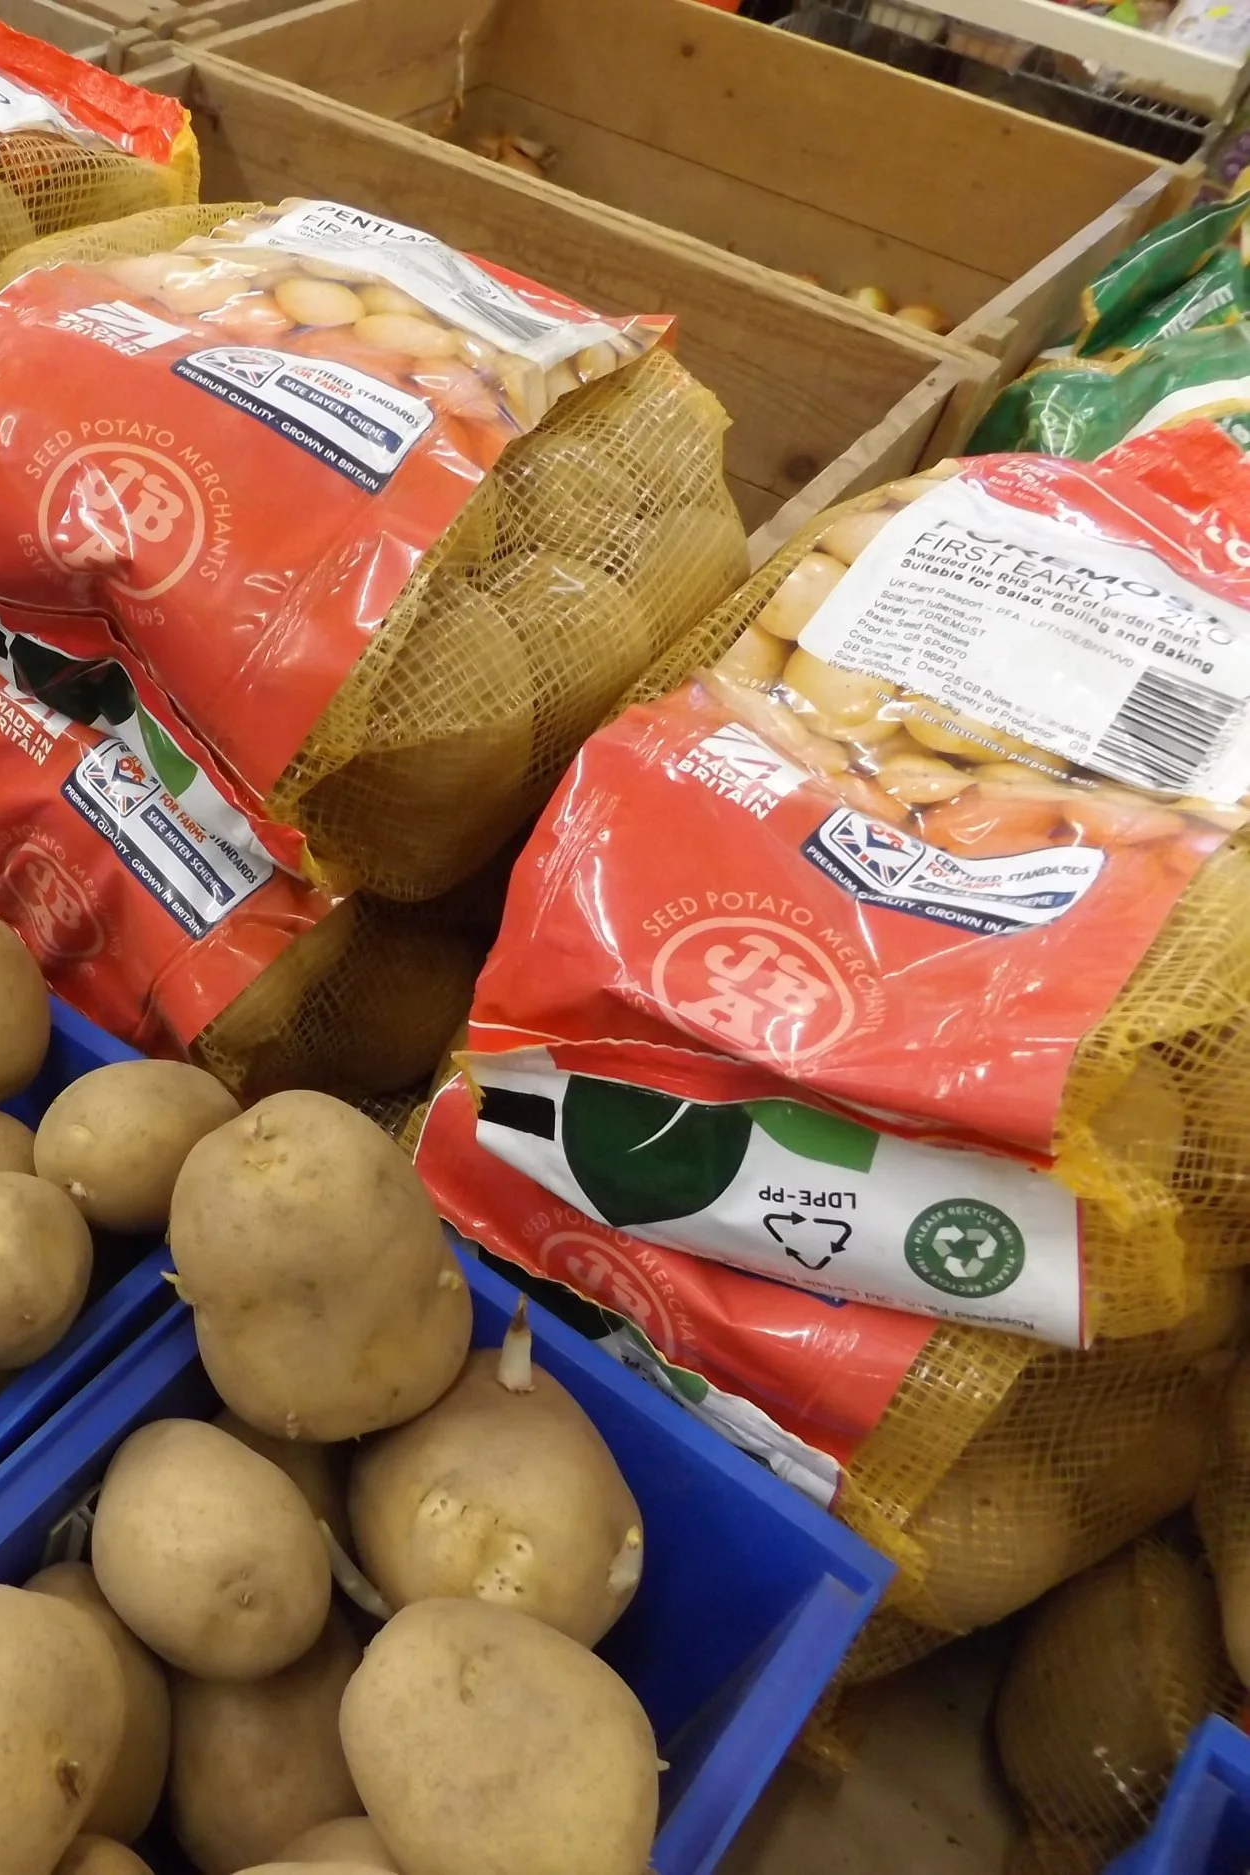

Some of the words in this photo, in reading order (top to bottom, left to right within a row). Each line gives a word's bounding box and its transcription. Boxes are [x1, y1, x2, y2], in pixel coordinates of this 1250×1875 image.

[54, 319, 138, 357] BRITAIN
[281, 378, 307, 397] SAFE
[308, 389, 344, 415] HAVEN
[344, 410, 387, 441] SCHEME
[289, 368, 312, 382] FOR
[313, 375, 352, 400] FARMS
[356, 388, 421, 429] STANDARDS
[177, 364, 228, 396] PREMIUM
[228, 391, 276, 422] QUALITY
[281, 420, 325, 453] GROWN
[323, 447, 337, 463] IN
[338, 458, 380, 490] BRITAIN
[25, 430, 72, 480] SEED
[80, 419, 175, 448] POTATO
[178, 446, 233, 583] MERCHANTS
[888, 577, 907, 589] UK
[908, 582, 936, 595] Plant
[936, 587, 985, 611] Passport
[905, 547, 968, 569] Awarded
[971, 565, 994, 578] the
[997, 572, 1030, 589] RHS
[1032, 585, 1080, 603] award
[1082, 599, 1100, 610] of
[1101, 606, 1155, 633] garden
[914, 532, 1009, 566] FIRST
[1012, 560, 1123, 601] EARLY
[934, 520, 1229, 628] OREMOS
[849, 629, 874, 646] Crop
[875, 640, 914, 654] number
[857, 618, 882, 635] Prod
[903, 632, 921, 642] GB
[865, 609, 894, 626] Basic
[896, 617, 923, 631] Seed
[924, 623, 971, 648] Potatoes
[873, 599, 908, 617] Variety
[917, 608, 987, 639] FOREMOST
[900, 558, 964, 581] Suitable
[967, 575, 993, 590] for
[1050, 602, 1110, 634] Boiling
[1114, 629, 1150, 648] and
[1151, 641, 1216, 675] Baking
[834, 650, 857, 662] Size
[842, 640, 861, 652] GB
[862, 648, 893, 662] Grade
[901, 656, 912, 667] E
[963, 681, 983, 695] GB
[982, 690, 1013, 709] Rules
[35, 733, 53, 754] IN
[920, 710, 938, 724] for
[940, 719, 1007, 756] illustration
[1007, 752, 1069, 781] purposes
[941, 683, 983, 711] Country
[985, 704, 999, 715] of
[1068, 740, 1090, 754] GB
[676, 758, 770, 822] BRITAIN
[686, 748, 752, 792] MADE
[750, 788, 781, 811] IN
[159, 792, 179, 815] FOR
[177, 813, 207, 844] FARMS
[64, 784, 99, 821] PREMIUM
[97, 817, 130, 856] QUALITY
[131, 857, 163, 894] GROWN
[160, 888, 173, 905] IN
[170, 901, 204, 937] BRITAIN
[145, 810, 166, 834] SAFE
[165, 829, 192, 861] HAVEN
[190, 855, 223, 892] SCHEME
[934, 853, 1002, 884] CERTIFIED
[1006, 864, 1091, 884] STANDARDS
[642, 897, 698, 938] SEED
[706, 891, 814, 927] POTATO
[806, 846, 858, 894] PREMIUM
[857, 888, 915, 911] QUALITY
[925, 905, 983, 929] GROWN
[983, 921, 1002, 934] IN
[758, 1185, 857, 1210] LDPE-PP
[914, 1210, 946, 1245] PLEASE
[947, 1206, 1001, 1226] RECYCLE
